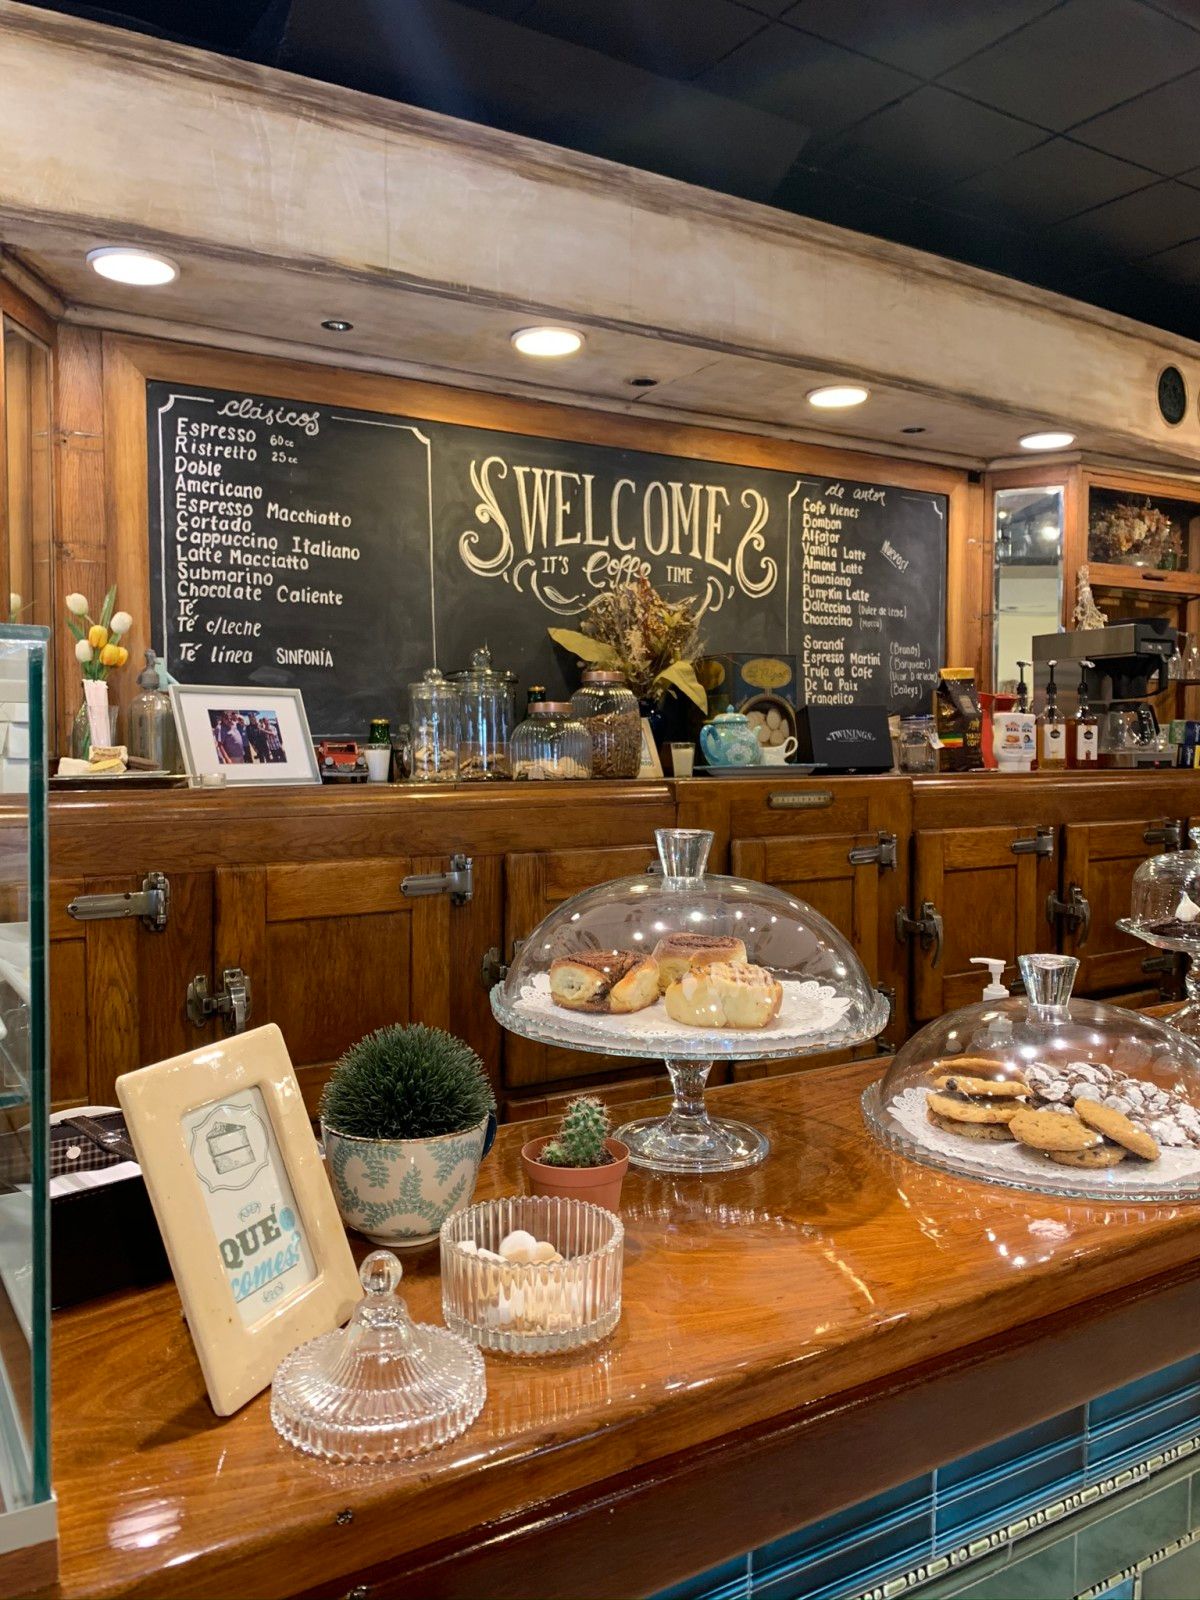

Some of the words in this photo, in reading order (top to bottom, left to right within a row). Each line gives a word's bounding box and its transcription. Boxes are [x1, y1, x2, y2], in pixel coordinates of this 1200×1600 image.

[176, 417, 257, 443] Espresso
[174, 434, 258, 461] Ristretto
[174, 455, 222, 477] Doble
[174, 473, 263, 500] Americano
[175, 492, 254, 517] Espresso
[266, 502, 352, 528] Macchiatto
[512, 465, 733, 576] WELCOME
[829, 503, 860, 519] Vienes
[175, 510, 252, 533] Cortado
[802, 513, 842, 530] Bombon
[175, 526, 278, 550] Cappuccino
[291, 536, 361, 561] Italiano
[801, 527, 841, 546] Alfajor
[176, 544, 223, 564] Latte
[229, 549, 310, 571] Macciatto
[801, 541, 838, 558] Vanilla
[842, 546, 867, 561] Latte
[177, 561, 274, 587] Submarino
[541, 555, 569, 575] IT'S
[666, 565, 694, 584] TIME
[802, 554, 837, 572] Almond
[840, 561, 864, 575] Latte
[802, 570, 852, 587] Hawaiano
[177, 580, 262, 602] Chocolate
[276, 585, 344, 606] Caliente
[845, 588, 870, 603] Latte
[178, 598, 199, 616] Té
[177, 614, 199, 633] Té
[179, 643, 203, 663] Té
[276, 647, 334, 668] SINFONÍA
[803, 650, 845, 667] Espresso
[849, 652, 881, 667] Martini
[802, 663, 830, 680] Trufa
[834, 666, 845, 678] de
[804, 677, 818, 693] De
[823, 679, 833, 692] la
[838, 678, 858, 692] Paix
[829, 728, 873, 741] TWININGS
